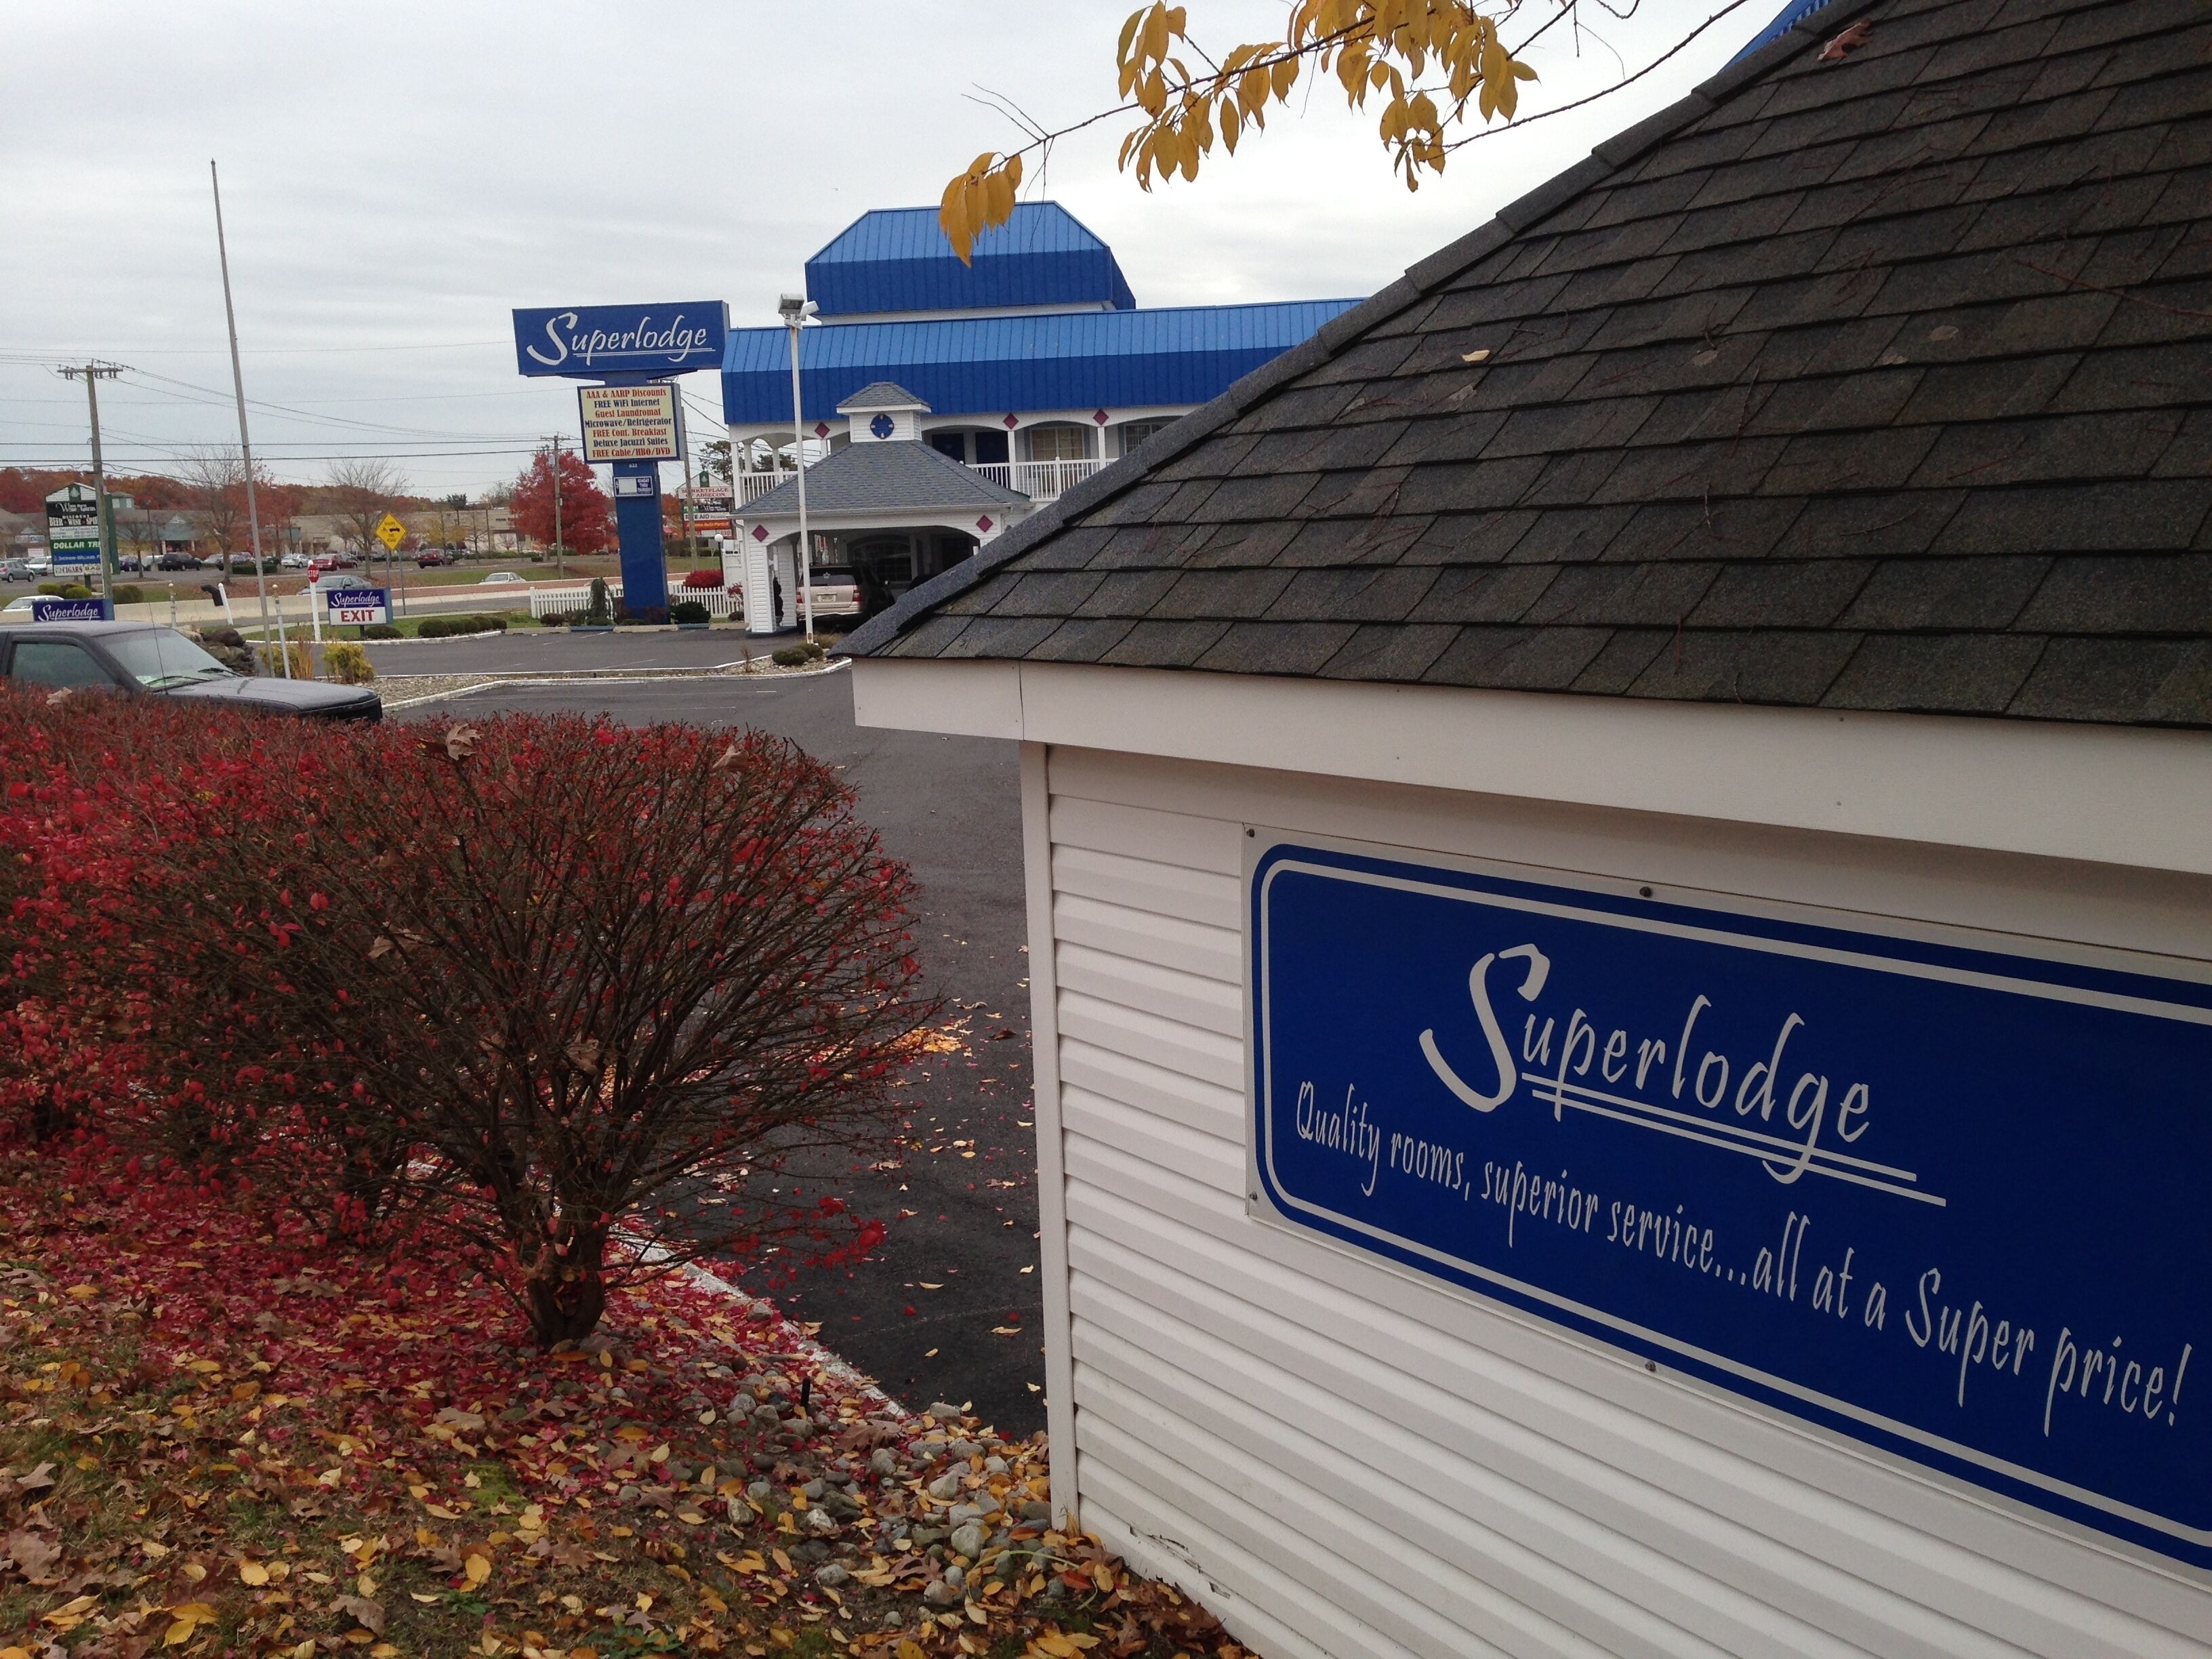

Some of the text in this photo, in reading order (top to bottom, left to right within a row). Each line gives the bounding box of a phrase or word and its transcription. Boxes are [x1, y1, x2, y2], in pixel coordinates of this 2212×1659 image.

[527, 312, 710, 366] Superlodge
[611, 390, 630, 398] AARP
[632, 388, 666, 396] Discounts
[594, 398, 660, 408] FREE WiFi Internet
[596, 408, 661, 418] Guest Laundromat
[585, 418, 672, 428] Microwave/Refrigerator
[612, 429, 630, 437] Cont.
[632, 428, 667, 436] Breakfast
[594, 437, 668, 447] Deluxe Jacuzzi Suites
[611, 447, 671, 457] Cable/HBO/DVD
[49, 517, 64, 526] BEER
[308, 569, 319, 577] STOP
[331, 591, 380, 607] Superlodge
[38, 602, 100, 621] Superlodge
[340, 609, 375, 622] EXIT
[1418, 943, 1875, 1185] Superlodge
[1296, 1080, 1380, 1197] Quality
[1390, 1132, 1470, 1202] rooms,
[1481, 1160, 1599, 1248] superior
[1812, 1246, 1856, 1319] at
[1864, 1281, 1887, 1331] a
[1905, 1267, 2036, 1408] Super
[2043, 1326, 2193, 1438] price!
